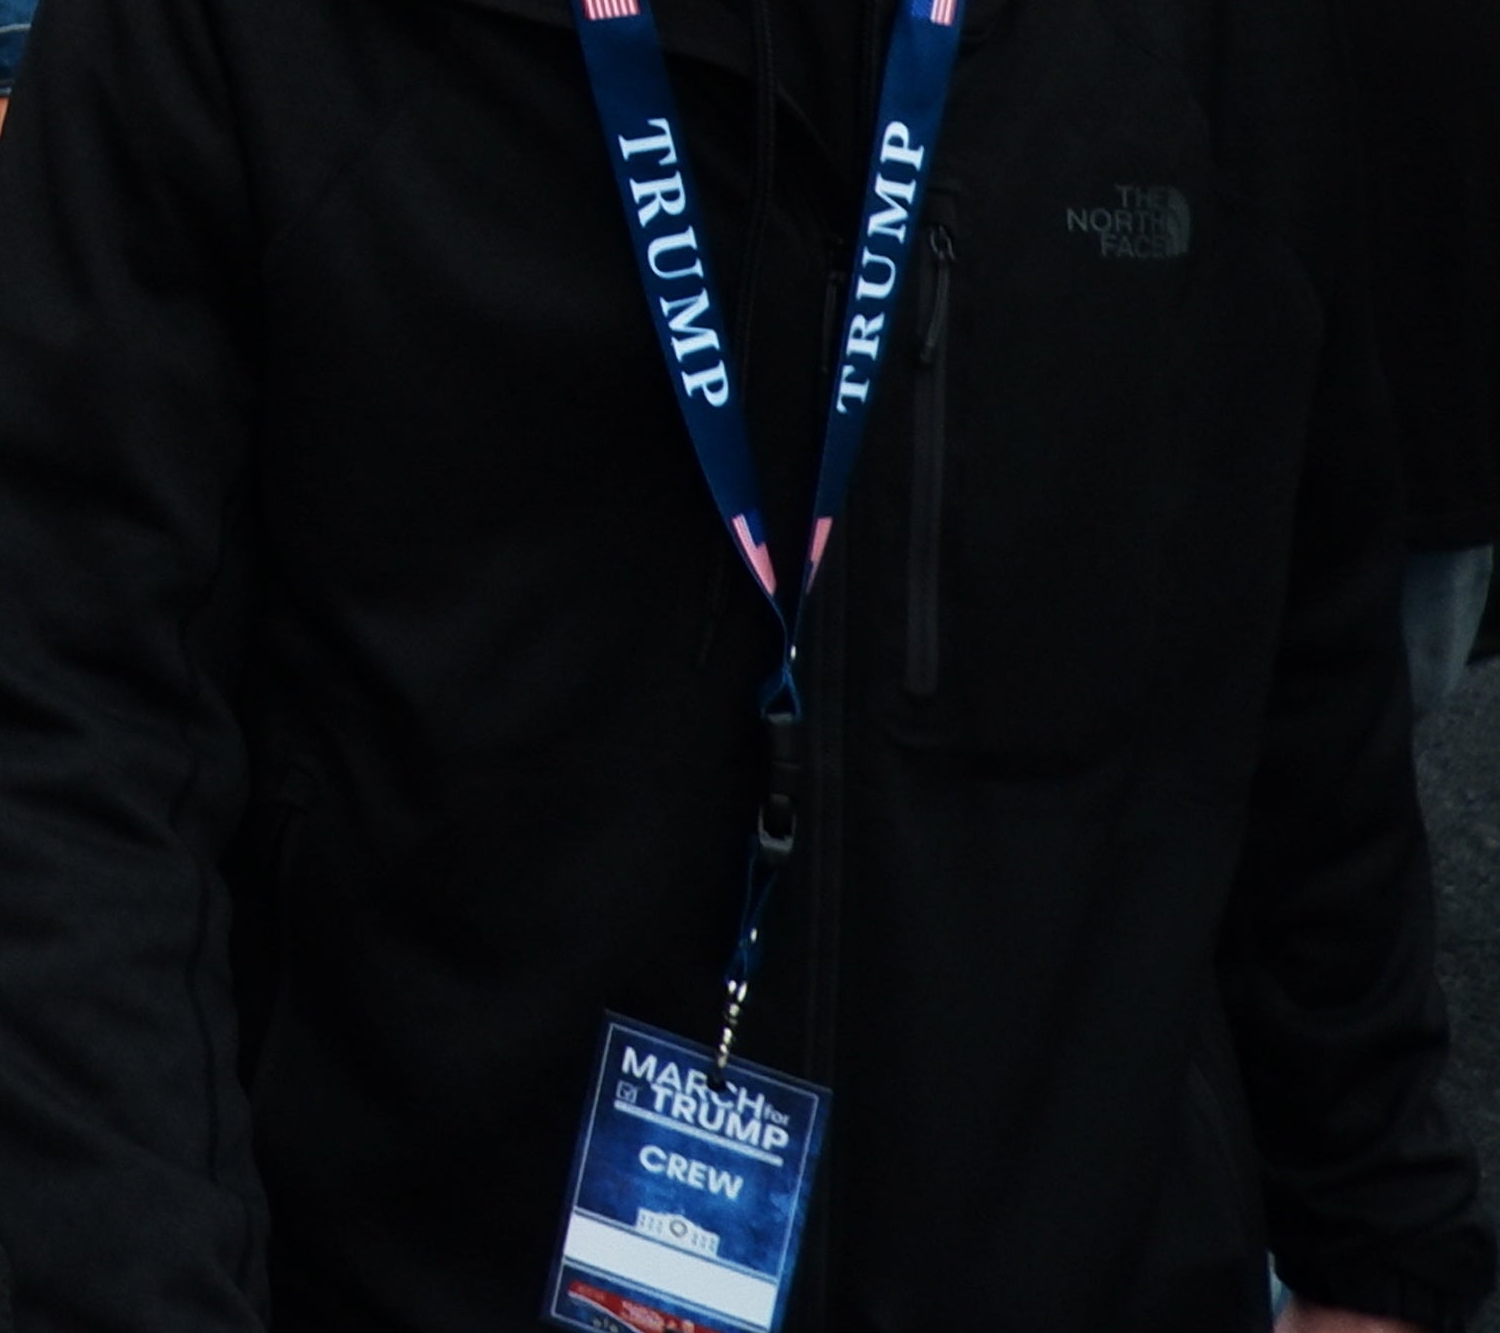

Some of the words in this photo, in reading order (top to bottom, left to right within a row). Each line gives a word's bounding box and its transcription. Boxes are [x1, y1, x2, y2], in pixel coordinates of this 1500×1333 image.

[1066, 208, 1168, 232] NORTH
[1115, 184, 1167, 208] THE
[616, 116, 731, 409] TRUMP
[836, 118, 927, 415] TRUMP
[1100, 234, 1166, 259] FACE
[621, 1046, 765, 1121] MARCH
[764, 1103, 791, 1127] for
[651, 1082, 790, 1151] TRUMP
[638, 1144, 745, 1201] CREW
